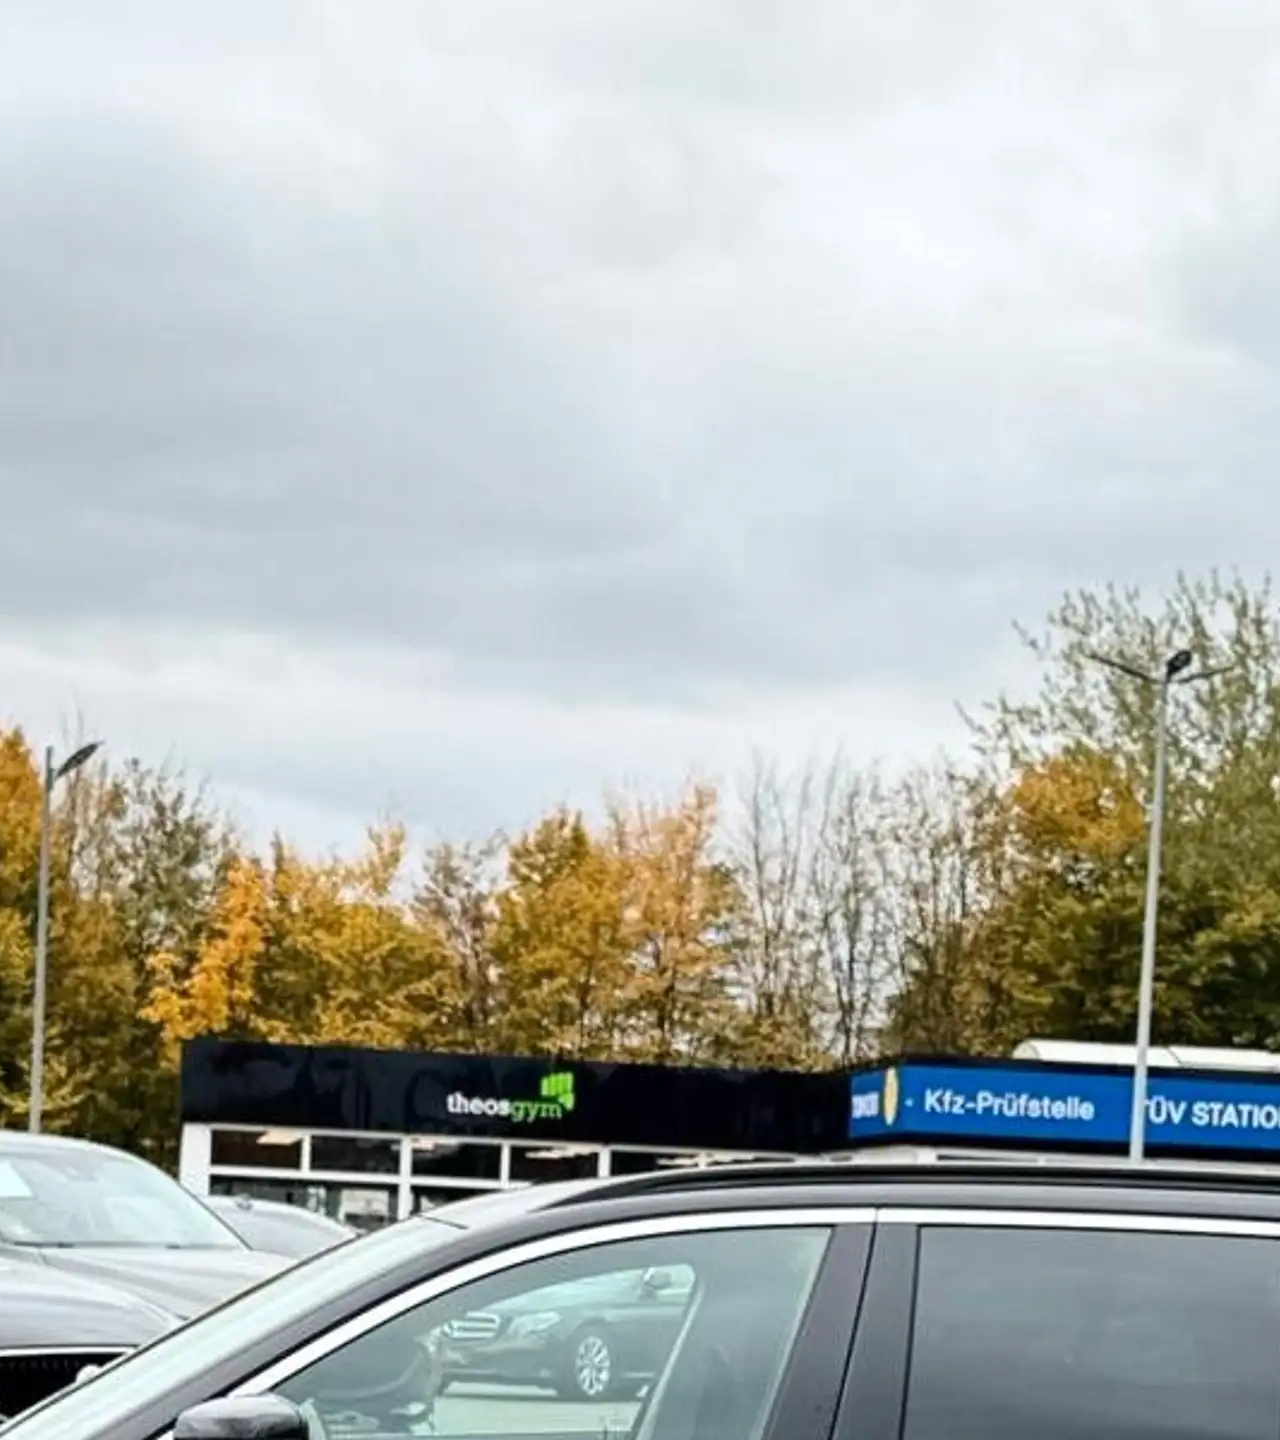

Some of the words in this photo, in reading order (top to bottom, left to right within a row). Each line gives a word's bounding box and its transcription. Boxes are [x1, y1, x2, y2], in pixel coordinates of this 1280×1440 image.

[446, 1090, 562, 1123] theosgym
[923, 1087, 1096, 1121] Kfz-Prüfstelle
[1144, 1095, 1186, 1126] ÜV
